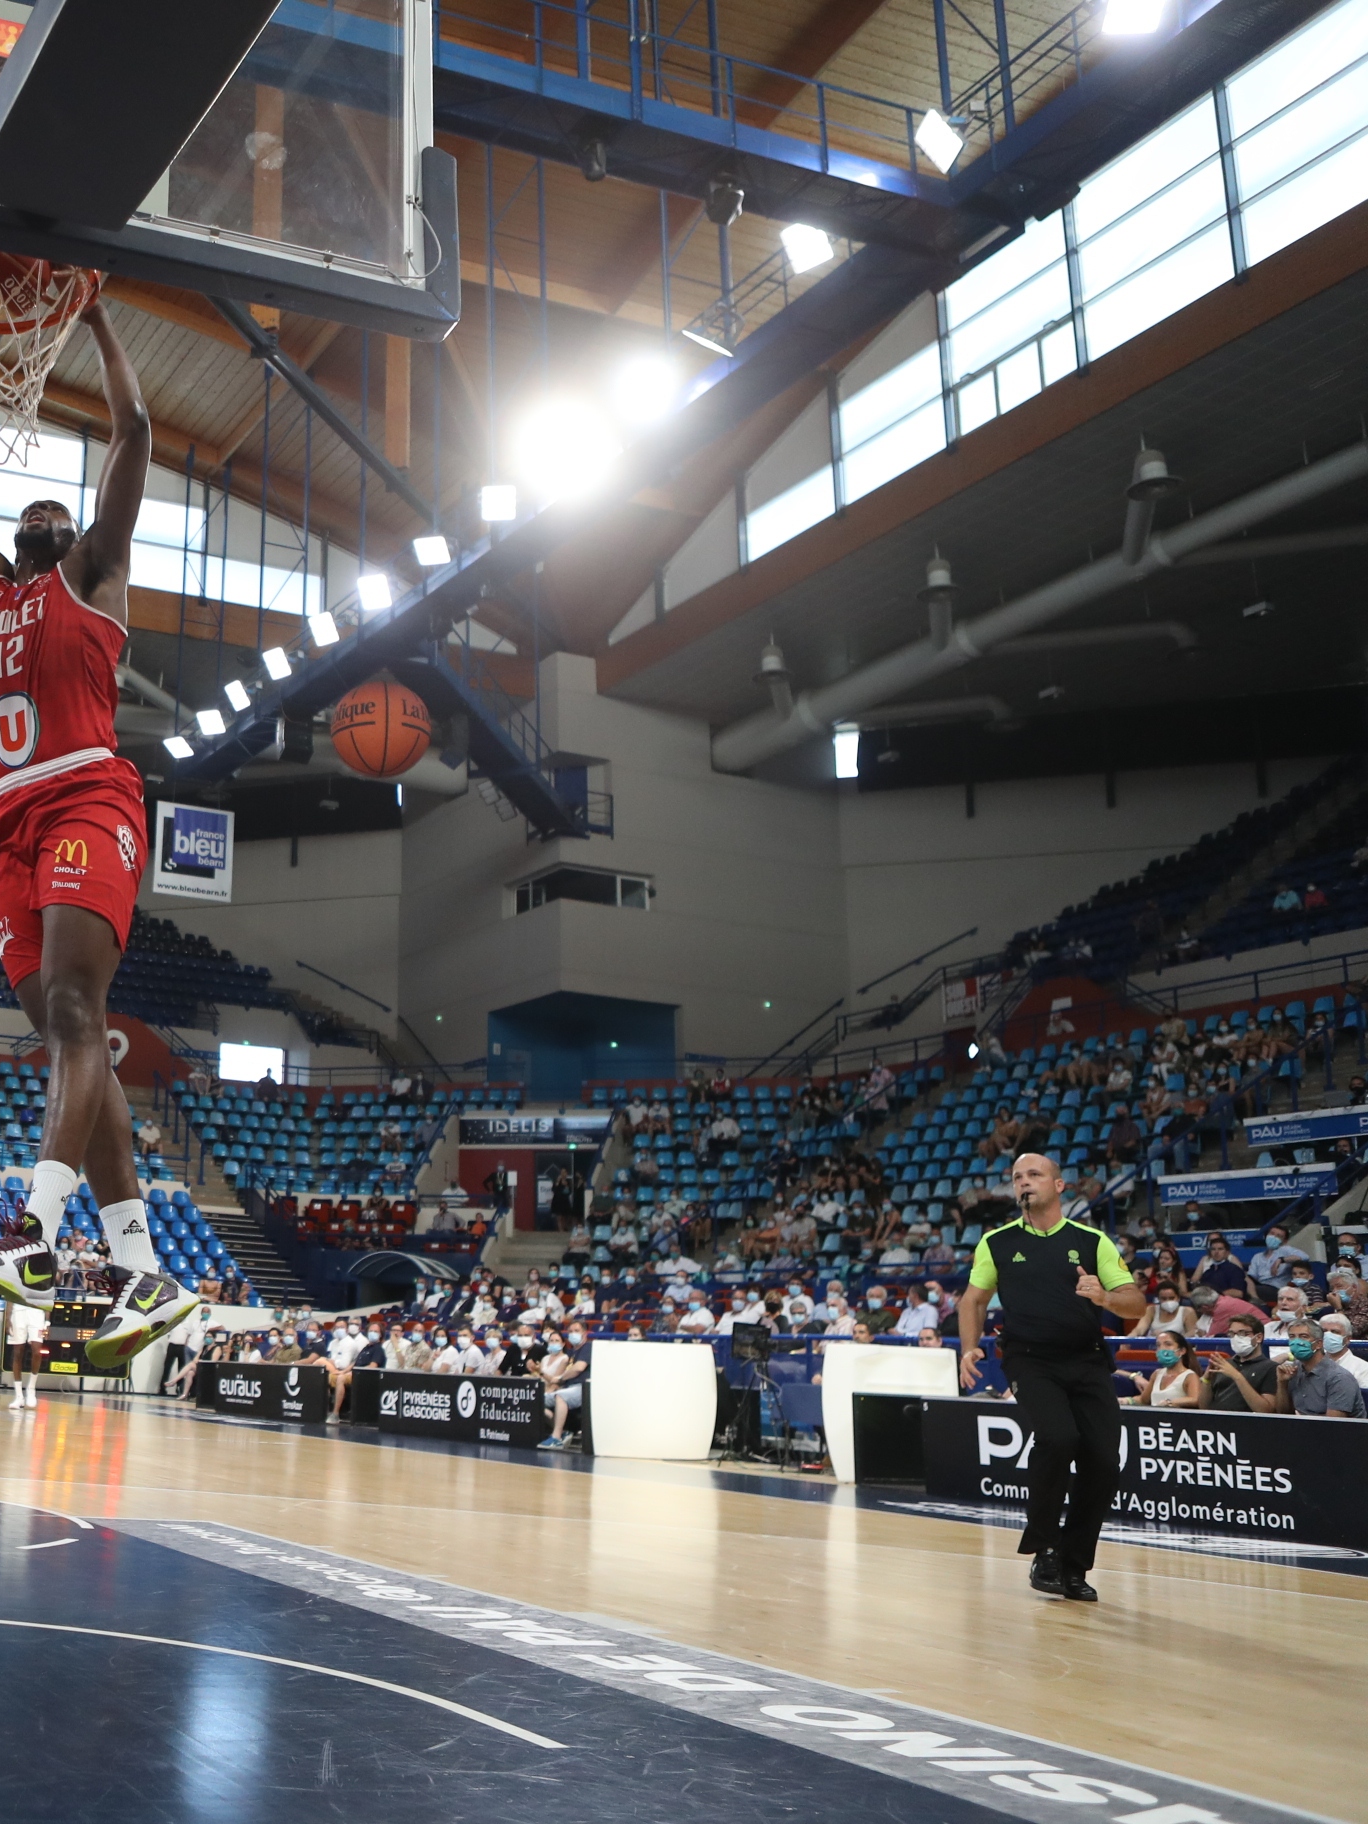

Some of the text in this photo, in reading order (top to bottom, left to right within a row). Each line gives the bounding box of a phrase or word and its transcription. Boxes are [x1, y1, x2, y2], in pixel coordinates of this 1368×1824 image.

[196, 829, 225, 840] france
[175, 829, 224, 859] bleu
[198, 856, 223, 867] béarn
[54, 866, 87, 876] CHOLET
[51, 881, 81, 890] SPALDING
[157, 882, 228, 898] www.bleubearn.fr
[489, 1119, 550, 1134] IDELIS
[1252, 1125, 1282, 1139] PAU
[1167, 1184, 1198, 1198] PAU
[1264, 1177, 1297, 1191] PAU
[123, 1227, 146, 1235] PEAK
[52, 1363, 78, 1372] Bodet
[402, 1390, 451, 1408] PYRÉNÉES
[480, 1384, 536, 1405] compagnie
[402, 1405, 451, 1421] GASCOGNE
[480, 1402, 531, 1423] fiduciaire
[1138, 1421, 1238, 1457] BÉARN
[1140, 1455, 1293, 1495] PYRÉNÉES
[1111, 1490, 1296, 1531] d'Agglomération
[406, 1604, 618, 1647] PAU
[571, 1653, 779, 1693] DE
